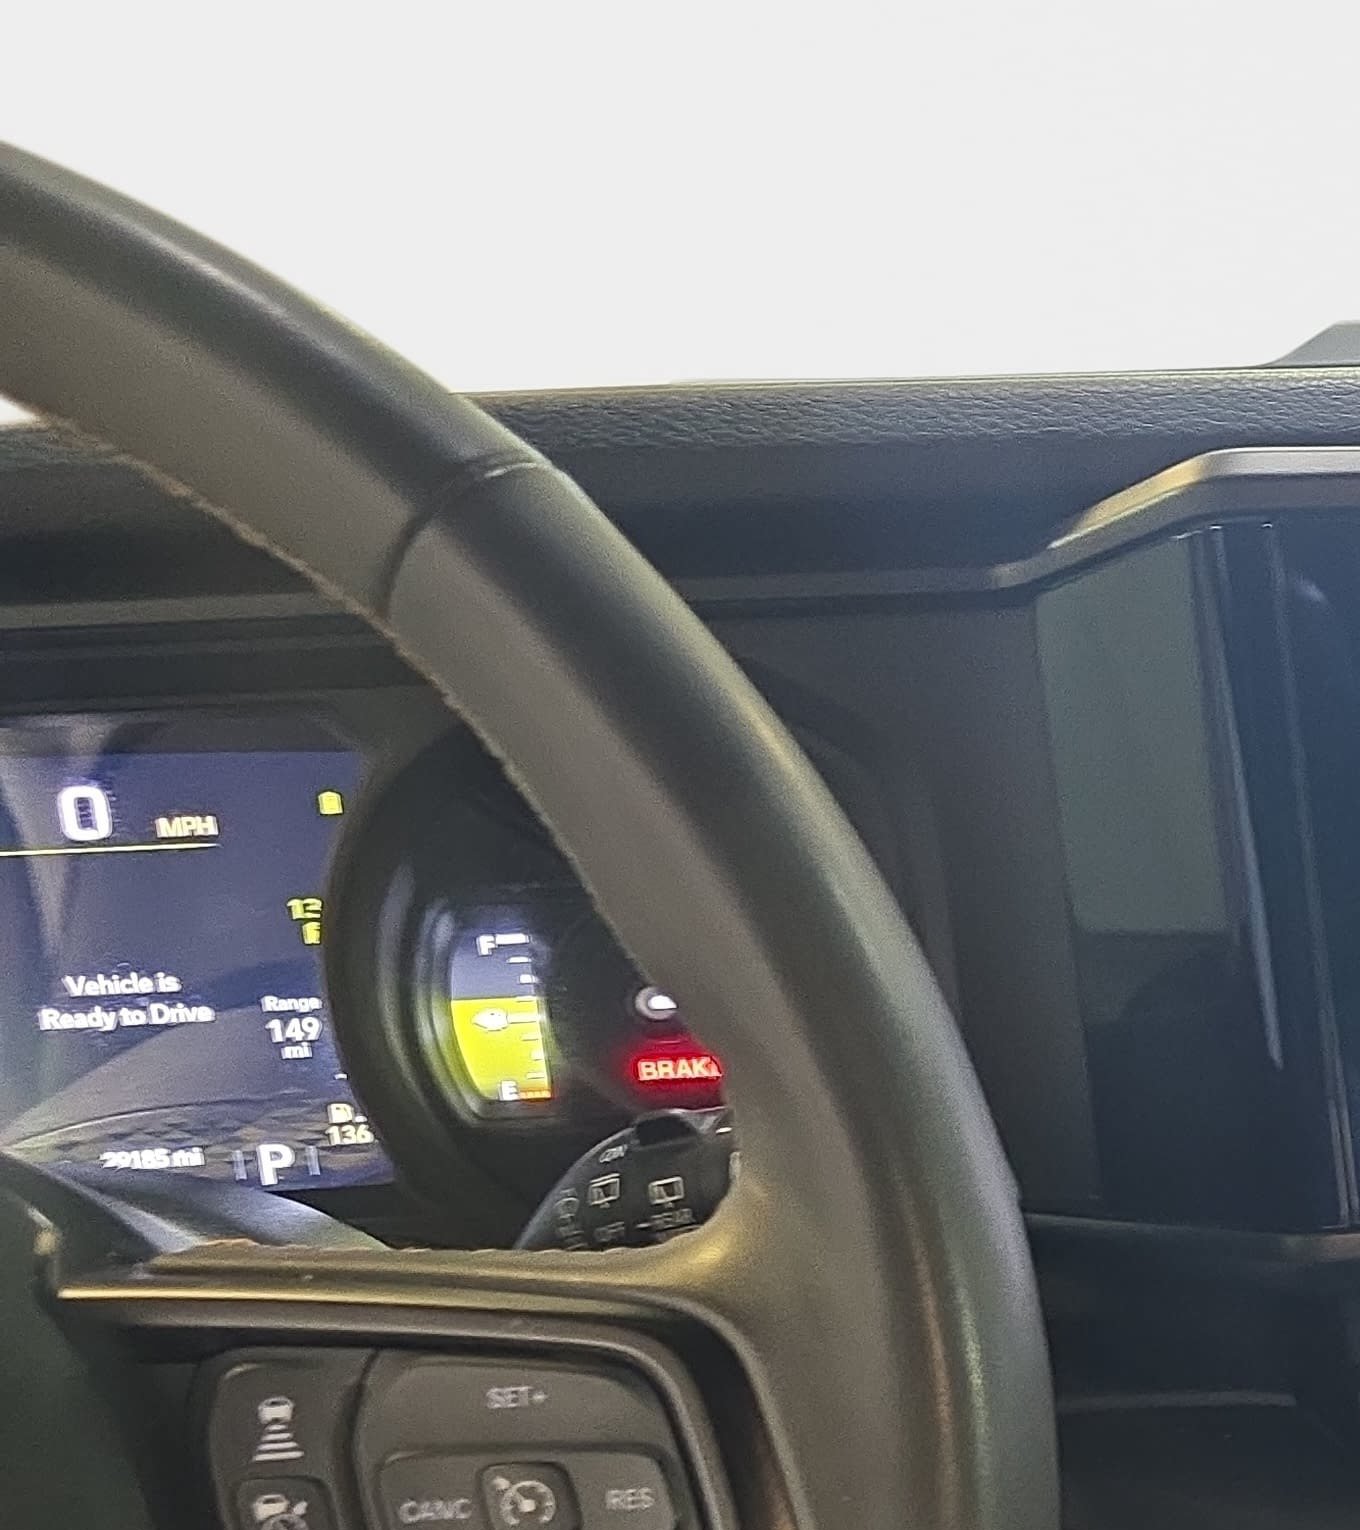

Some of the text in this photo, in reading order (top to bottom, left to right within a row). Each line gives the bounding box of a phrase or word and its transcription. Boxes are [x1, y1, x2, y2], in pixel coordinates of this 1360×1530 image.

[155, 815, 219, 838] MPH
[62, 971, 183, 998] Vehicle is
[261, 995, 323, 1014] Range
[38, 1004, 216, 1032] Ready to Drive
[265, 1016, 323, 1043] 149
[281, 1041, 313, 1060] mi
[172, 1146, 205, 1168] mi
[257, 1144, 296, 1186] P
